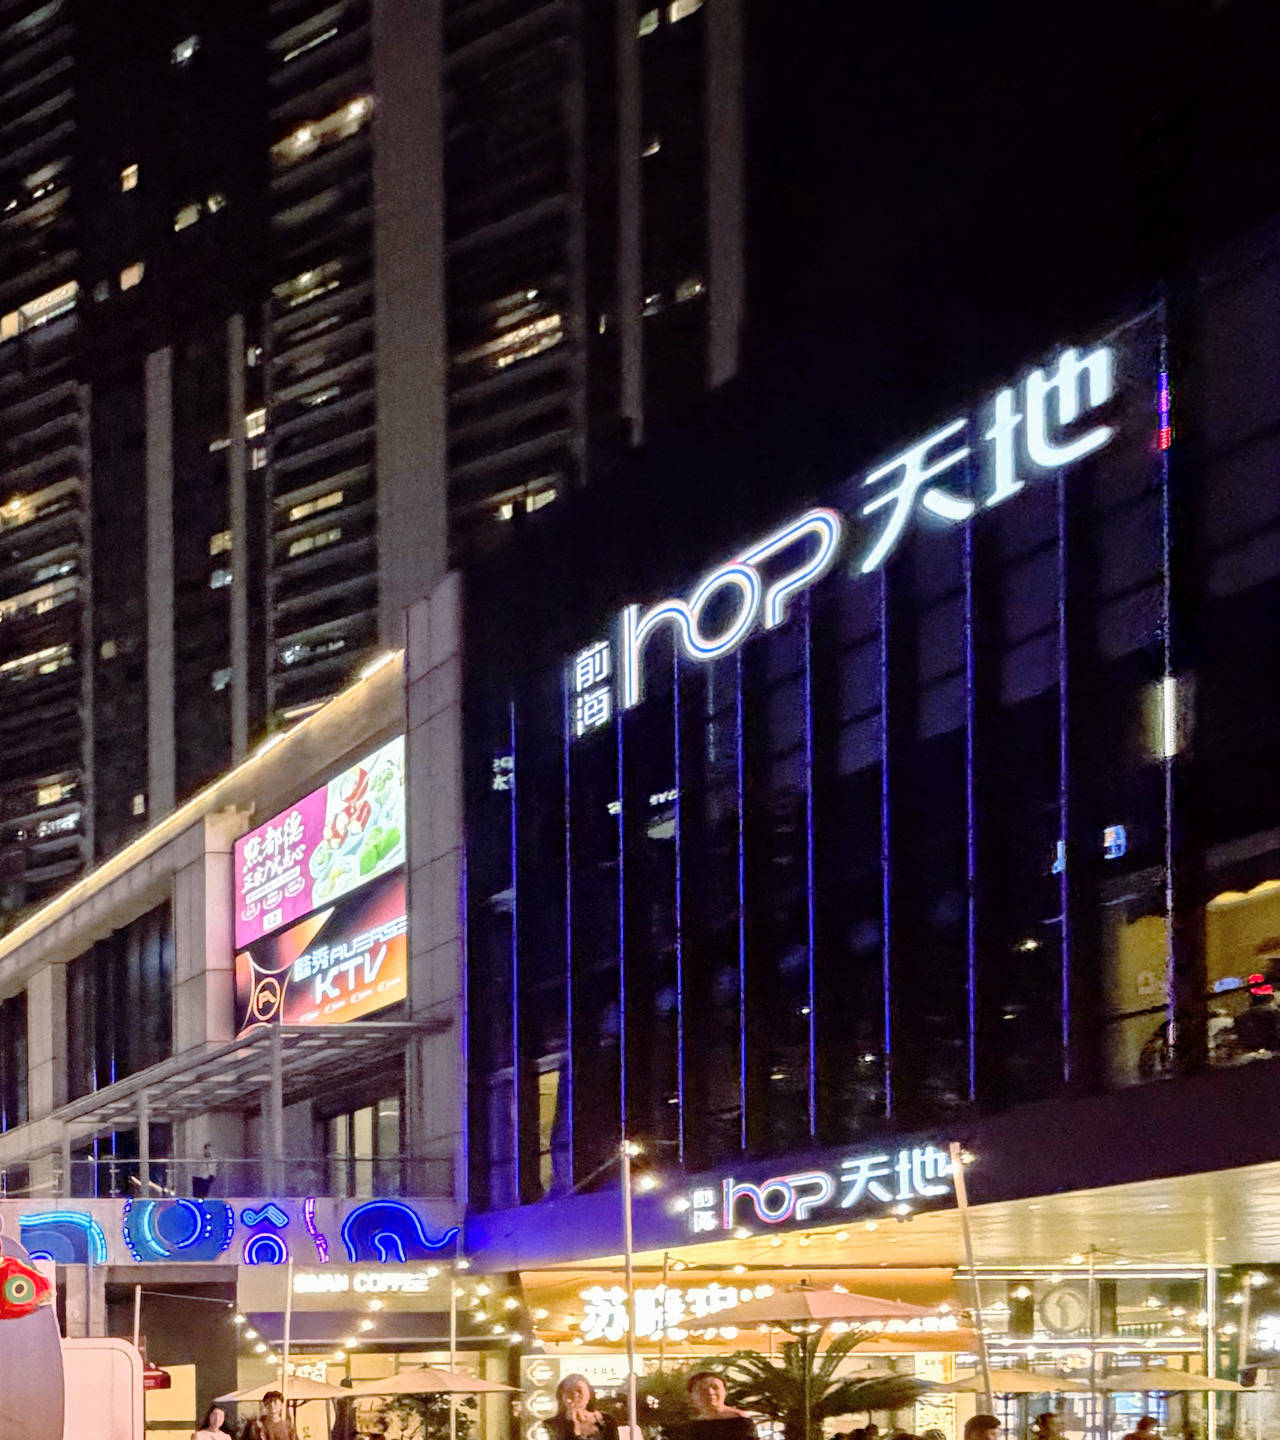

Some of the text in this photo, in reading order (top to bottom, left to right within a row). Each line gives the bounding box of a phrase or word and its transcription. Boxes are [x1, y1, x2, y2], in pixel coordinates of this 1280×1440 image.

[860, 346, 1120, 574] 天地
[575, 640, 610, 738] 前海
[315, 943, 388, 1004] KTV
[840, 1145, 952, 1209] 天地
